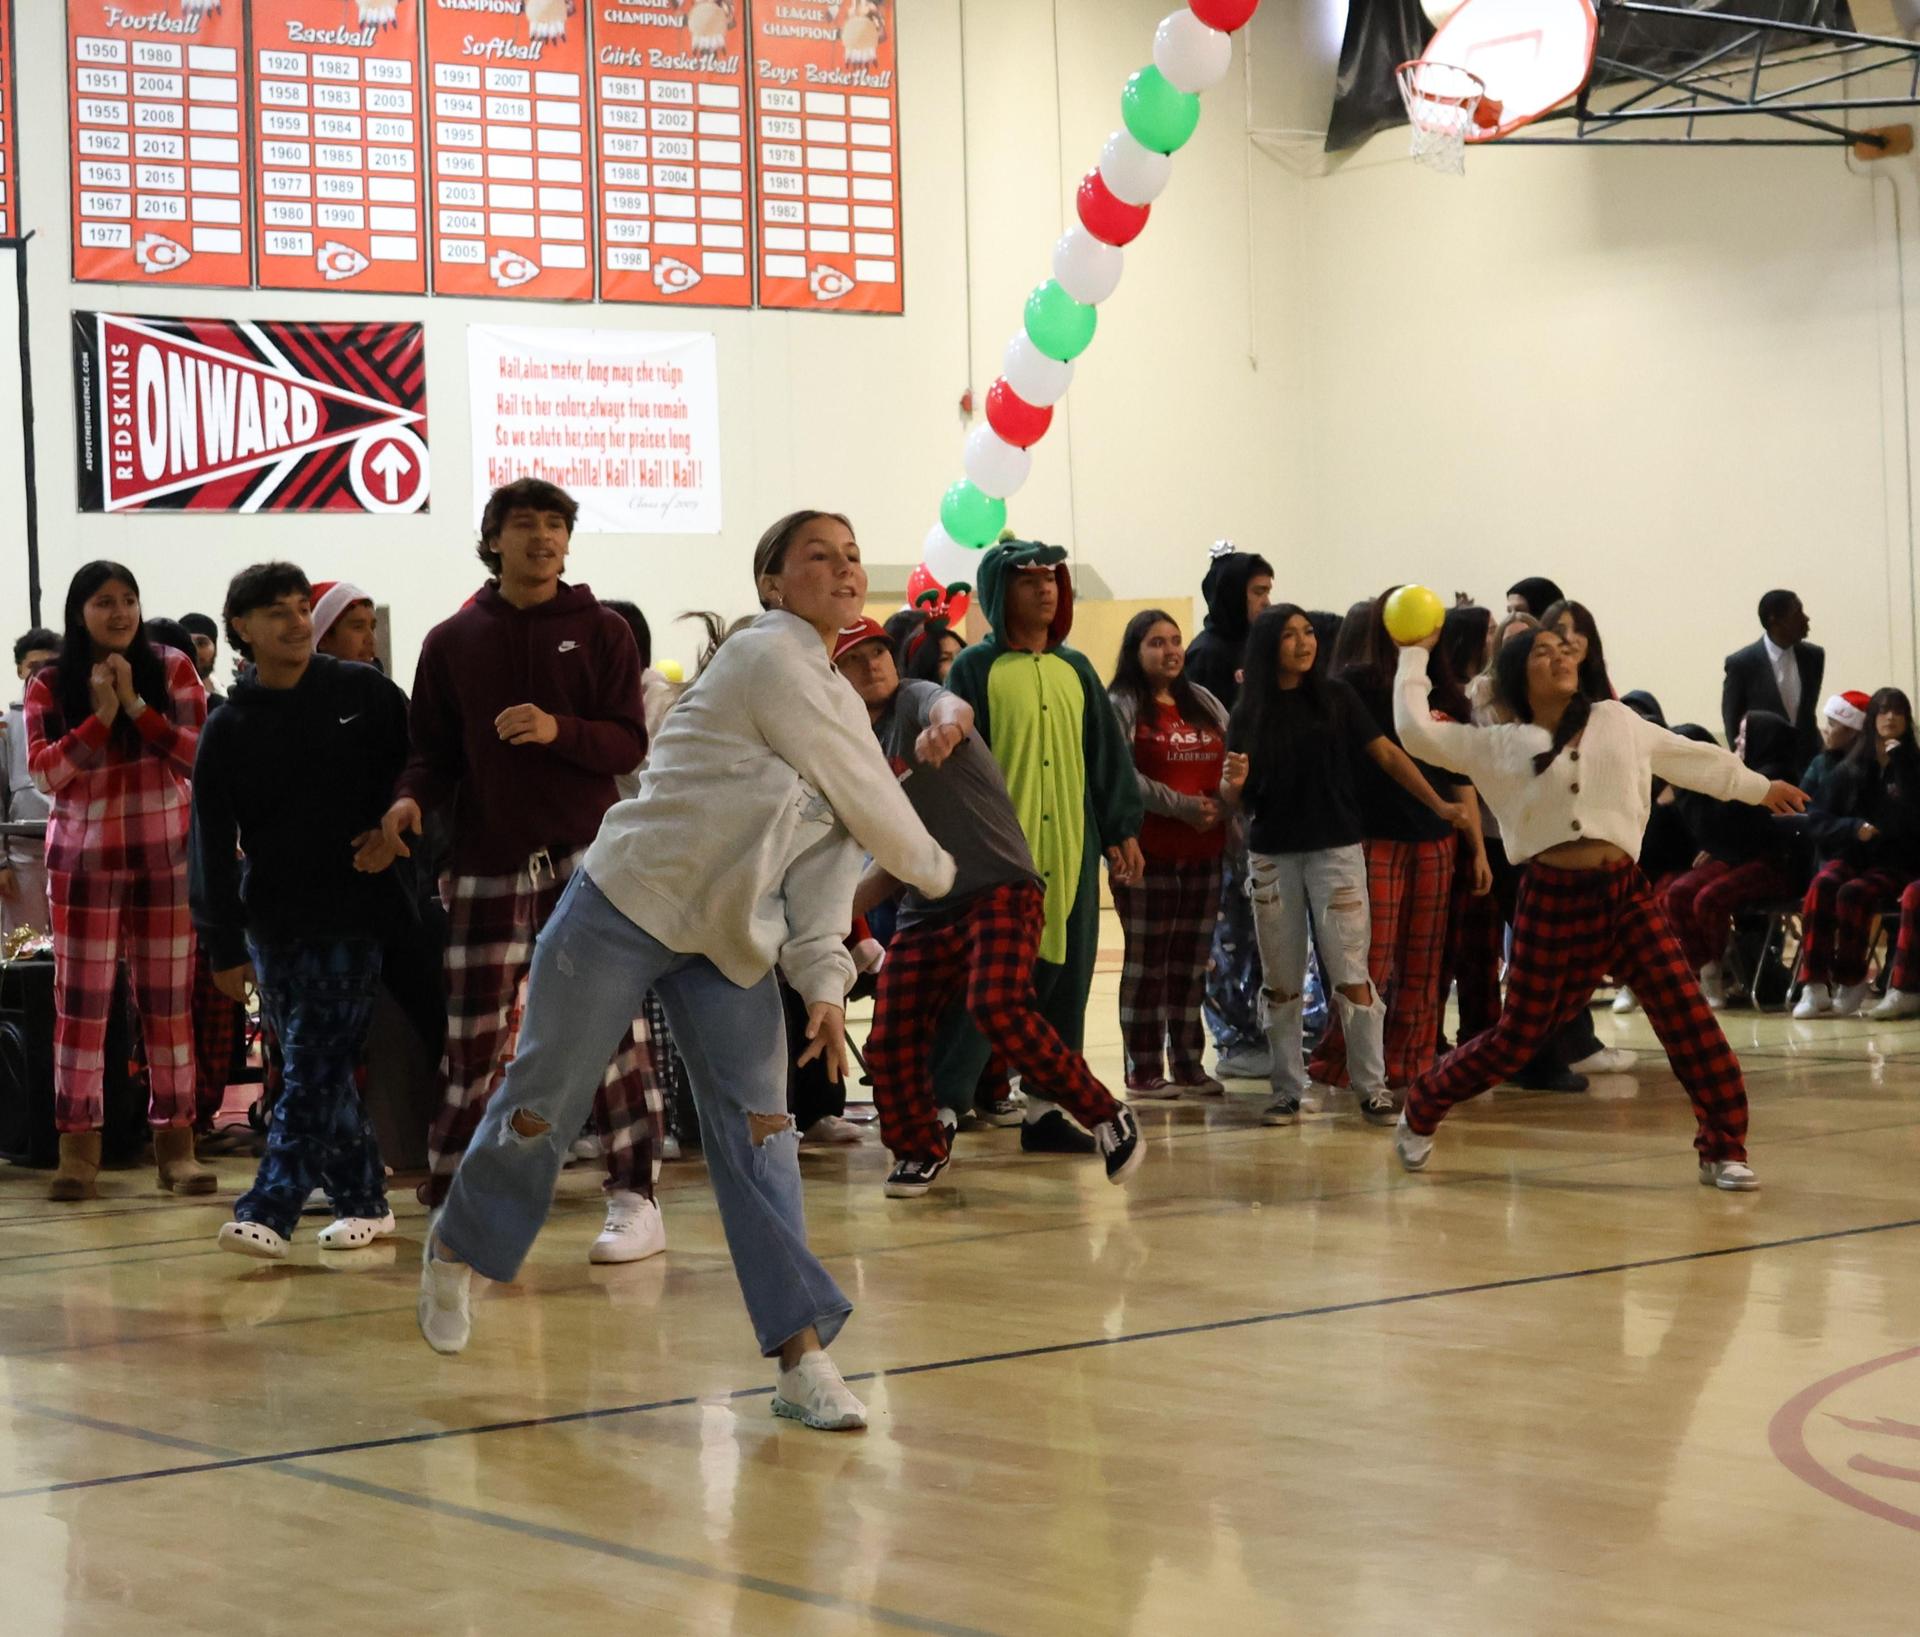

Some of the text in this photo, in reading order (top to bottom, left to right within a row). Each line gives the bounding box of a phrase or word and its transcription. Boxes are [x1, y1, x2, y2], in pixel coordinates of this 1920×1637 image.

[104, 6, 201, 34] Football
[776, 5, 825, 21] LEAGUE
[286, 19, 376, 48] Baseball
[85, 42, 173, 63] 1950 1980
[462, 34, 543, 61] Softball
[267, 56, 403, 79] 1920 1982 1993
[600, 44, 739, 73] Girls Basketball
[85, 73, 174, 92] 1951 2004
[442, 69, 524, 88] 1991 2007
[758, 59, 891, 88] Boys Basketball
[268, 85, 405, 108] 1958 1983 2003
[608, 82, 686, 99] 1981 2001
[443, 98, 525, 117] 1994 2018
[766, 93, 794, 107] 1974
[87, 104, 175, 124] 1955 2008
[609, 109, 688, 127] 1982 2002
[269, 116, 405, 137] 1959 1984 2010
[444, 127, 474, 141] 1995
[767, 120, 796, 135] 1975
[87, 135, 176, 155] 1962 2012
[610, 138, 688, 156] 1987 2003
[270, 145, 407, 167] 1960 1985 2015
[445, 156, 475, 171] 1996
[768, 148, 796, 162] 1978
[88, 167, 175, 185] 1963 2015
[611, 167, 688, 183] 1988 2004
[769, 176, 796, 190] 1981
[271, 176, 354, 193] 1977 1989
[445, 186, 476, 201] 2003
[88, 197, 178, 214] 1967 2016
[612, 196, 642, 210] 1989
[770, 204, 797, 218] 1982
[271, 206, 355, 222] 1980 1990
[446, 215, 477, 229] 2004
[89, 227, 123, 242] 1977
[613, 224, 643, 237] 1997
[272, 236, 303, 250] 1981
[447, 244, 478, 258] 2005
[614, 252, 642, 266] 1998
[586, 359, 609, 387] long
[612, 364, 633, 388] may
[636, 360, 654, 382] she
[657, 361, 683, 389] reign
[111, 343, 134, 480] REDSKINS
[137, 344, 319, 481] ONWARD
[497, 393, 518, 416] Hail
[521, 395, 532, 416] to
[535, 393, 551, 416] her
[629, 397, 650, 418] true
[653, 398, 688, 420] remain
[496, 424, 509, 446] So
[512, 430, 526, 446] we
[529, 425, 561, 447] salute
[609, 426, 625, 448] her
[629, 427, 666, 454] praises
[669, 427, 691, 455] long
[488, 456, 512, 486] Hail
[606, 458, 629, 487] Hail
[639, 459, 662, 487] Hail
[673, 459, 696, 488] Hail
